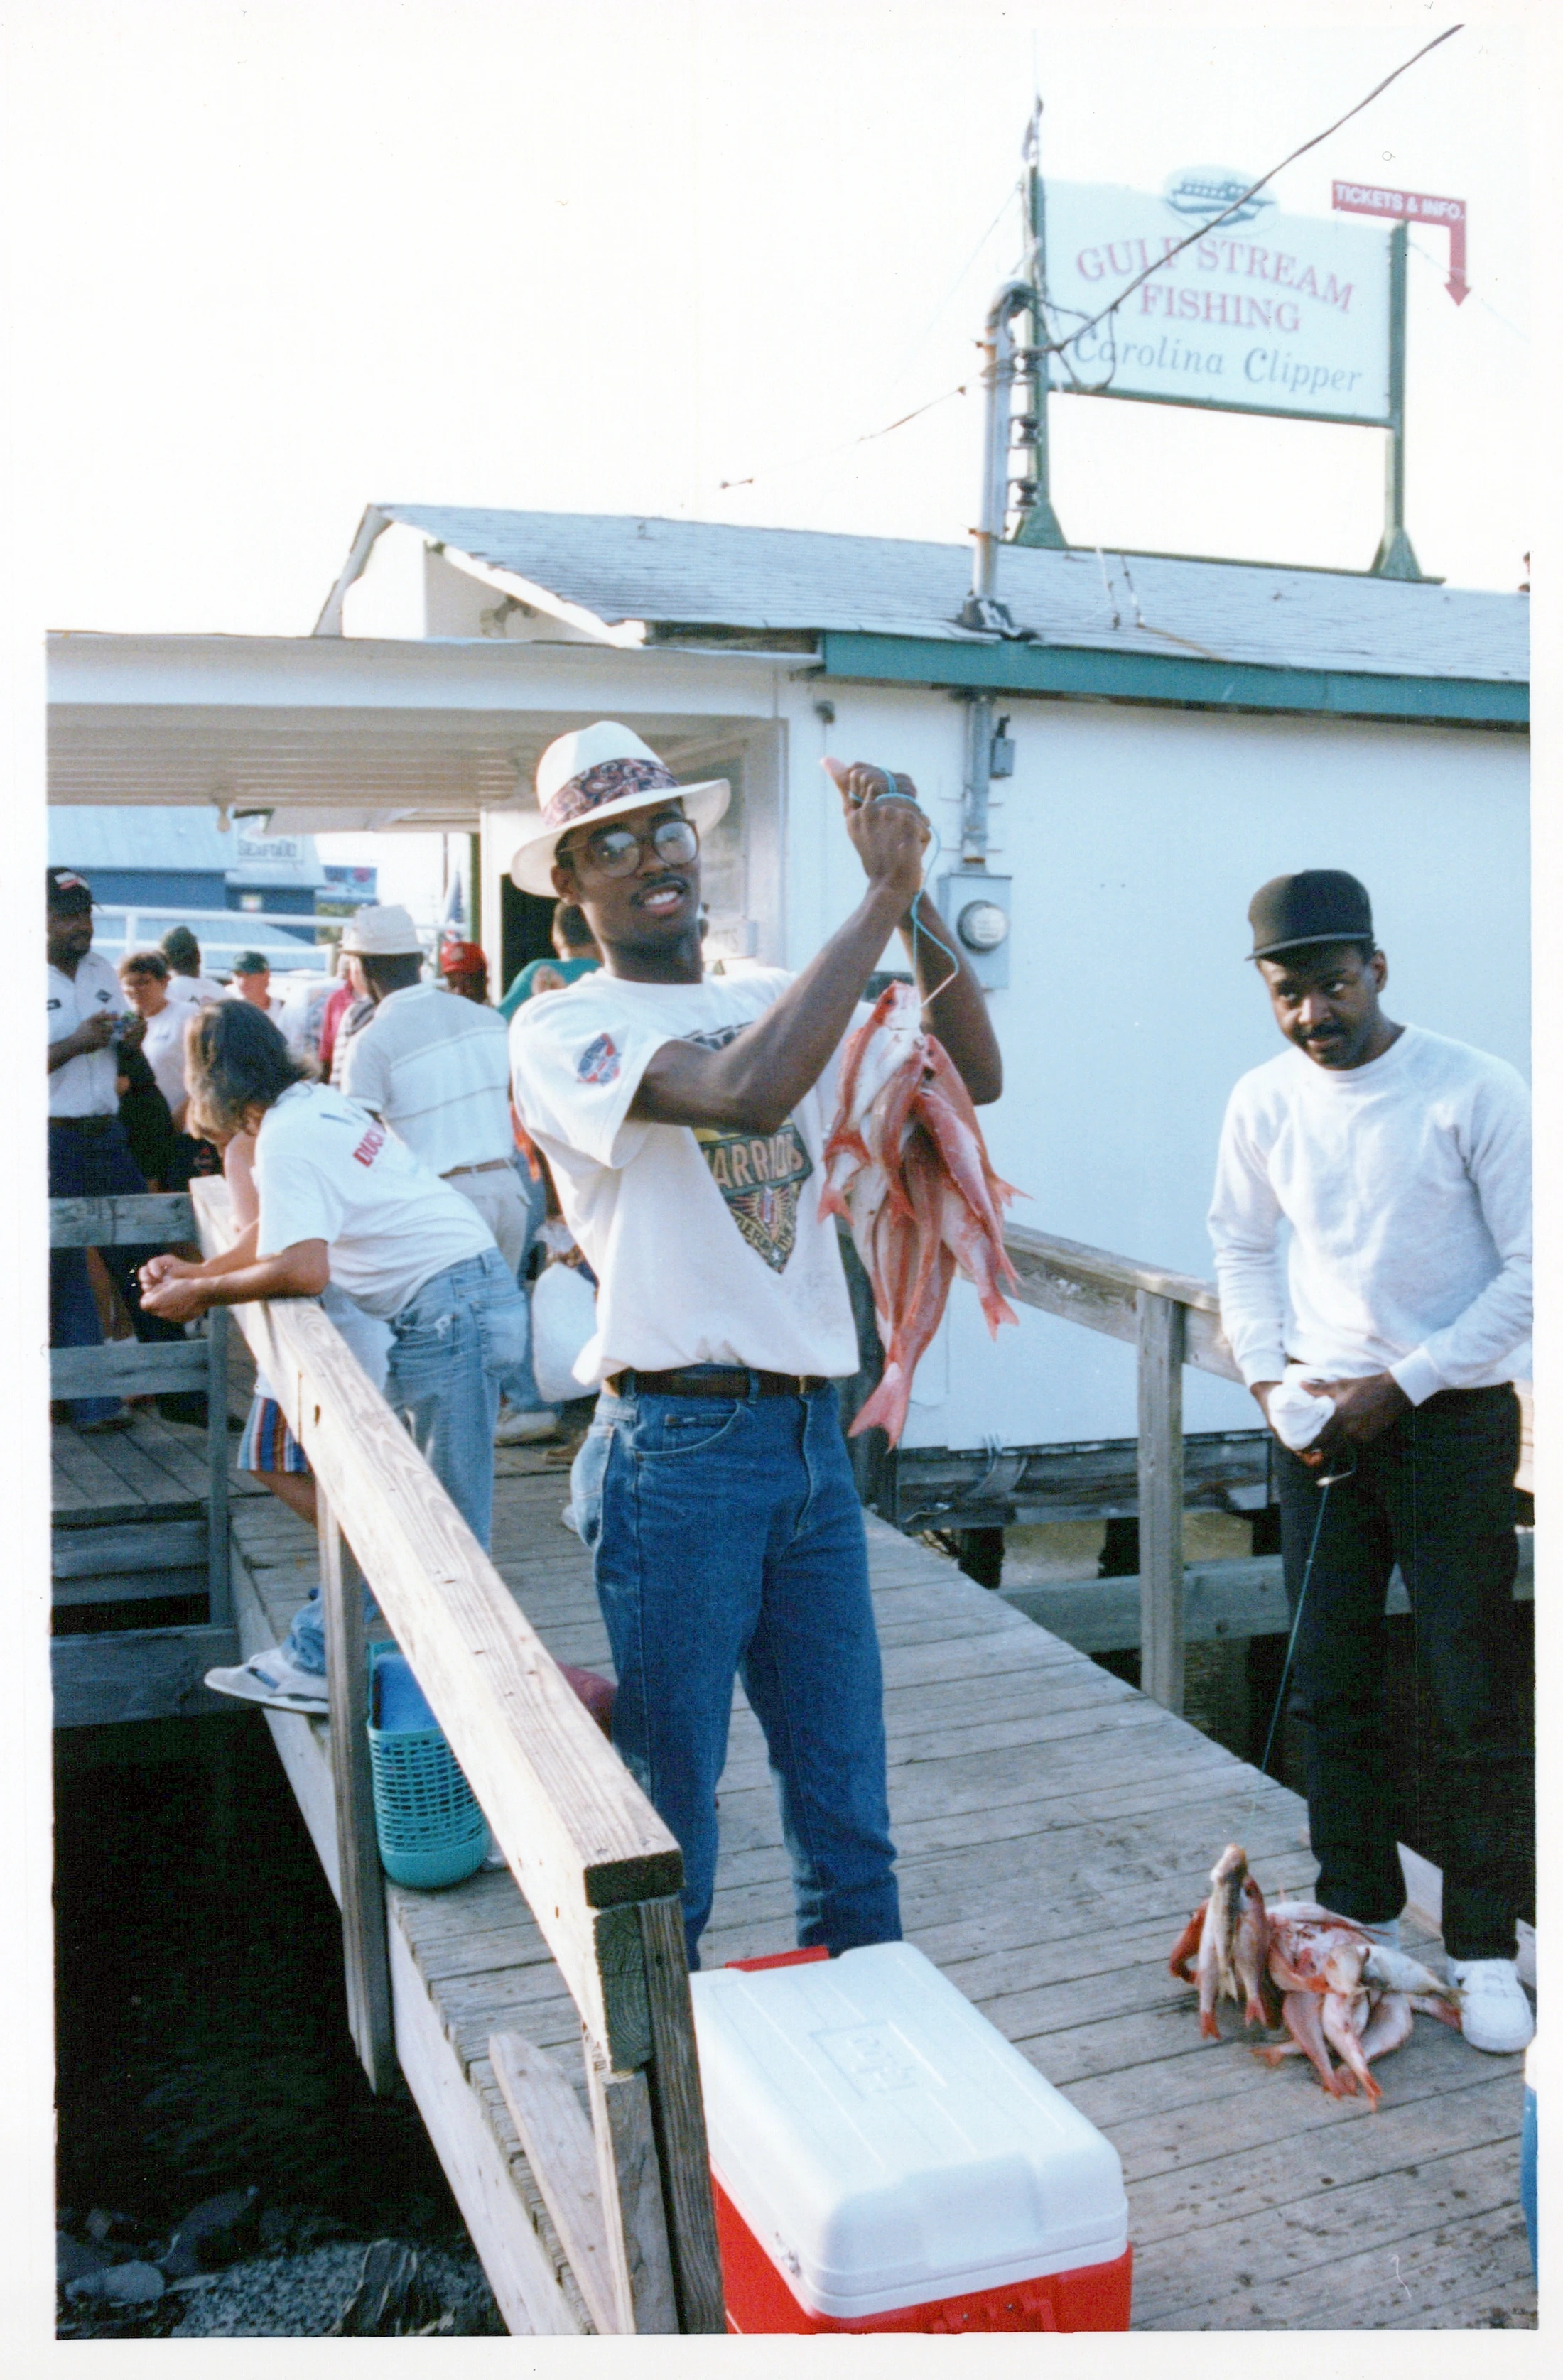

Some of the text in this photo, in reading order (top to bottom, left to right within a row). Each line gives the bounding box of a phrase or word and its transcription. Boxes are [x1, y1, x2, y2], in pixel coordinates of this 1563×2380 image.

[1335, 183, 1404, 212] TICKETS
[1407, 195, 1418, 213] &
[1076, 236, 1356, 313] GULF STREAM
[1139, 283, 1301, 333] FISHING
[1073, 322, 1363, 395] Carolina Clipper
